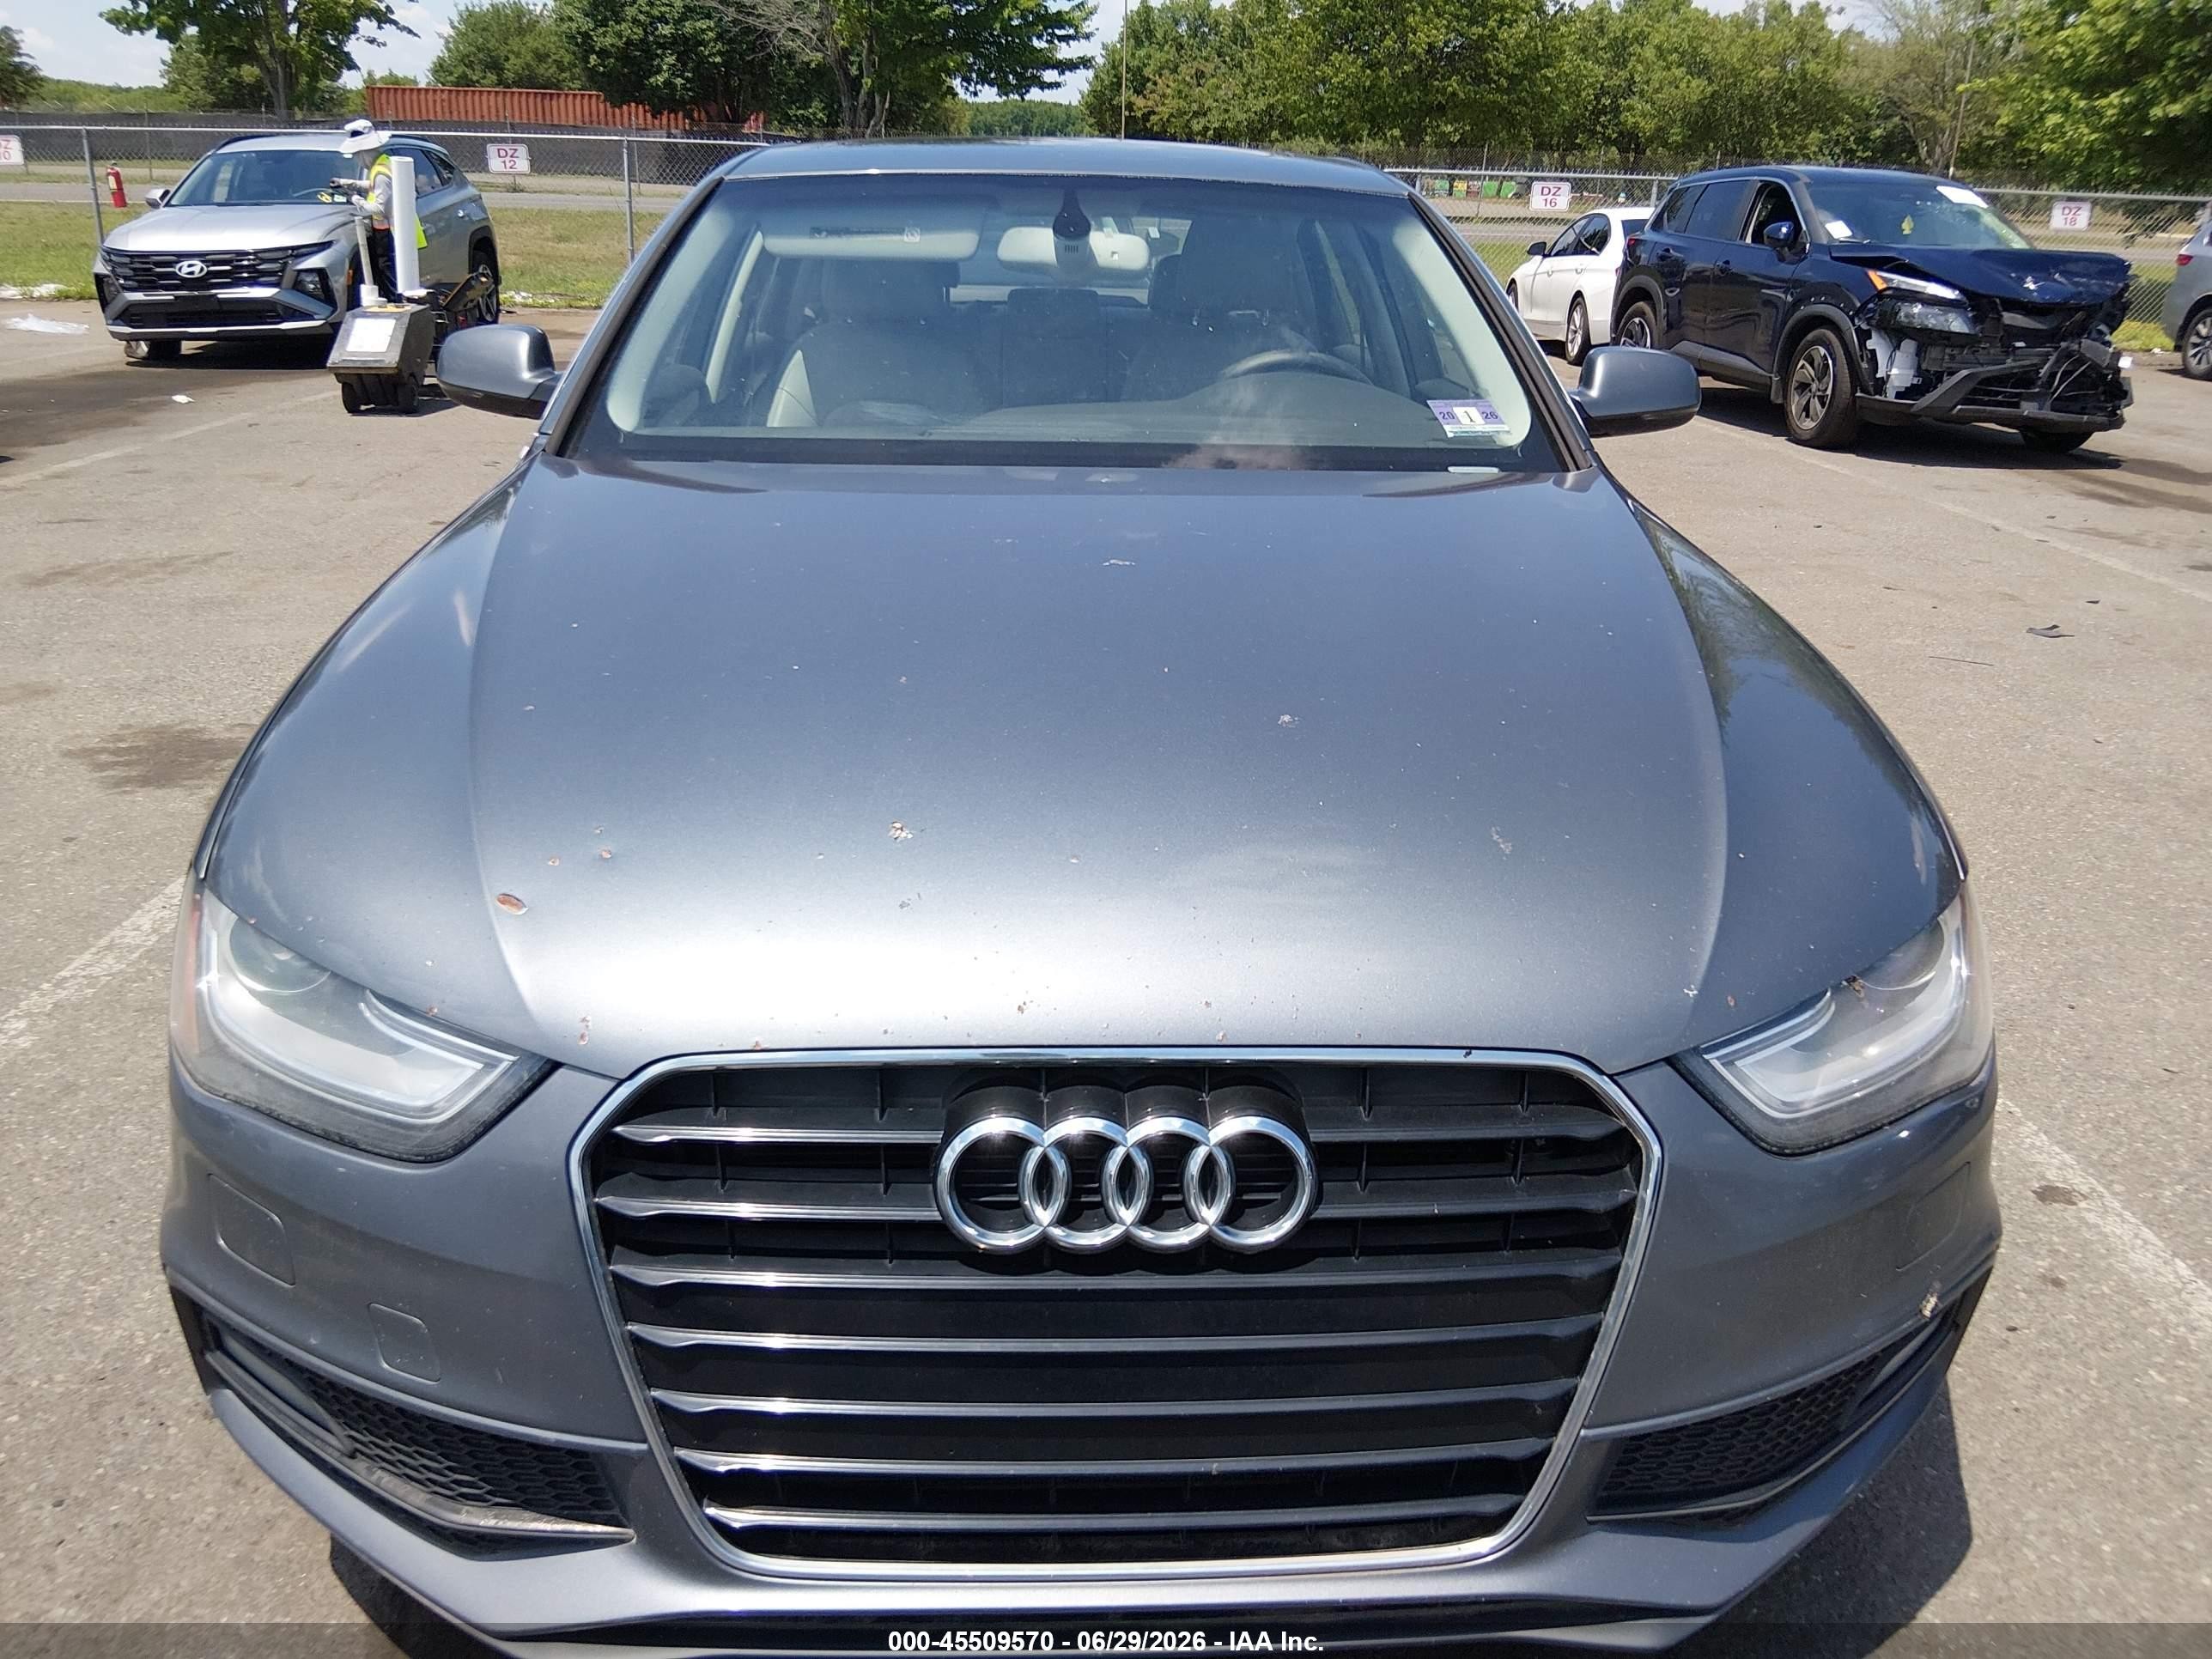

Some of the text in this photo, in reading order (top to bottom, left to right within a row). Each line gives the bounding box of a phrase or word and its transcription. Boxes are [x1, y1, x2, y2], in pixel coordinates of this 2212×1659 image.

[0, 138, 14, 150] Z
[497, 148, 520, 159] DZ
[501, 159, 518, 170] 12
[1540, 185, 1562, 197] DZ
[1542, 198, 1558, 208] 16
[2062, 205, 2082, 216] DZ
[2063, 216, 2077, 227] 18
[1439, 410, 1498, 423] 20 1 26
